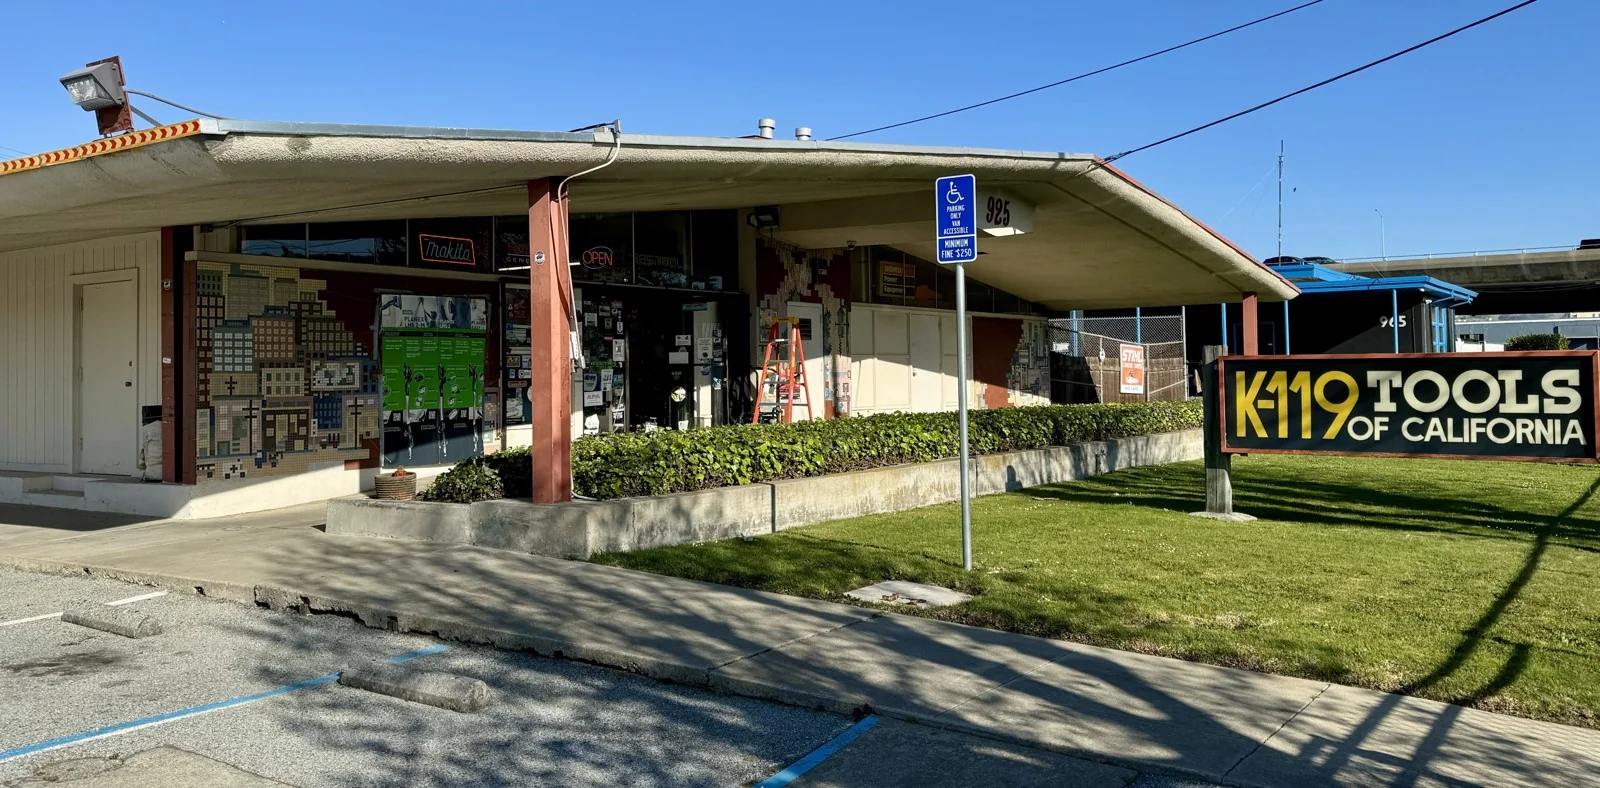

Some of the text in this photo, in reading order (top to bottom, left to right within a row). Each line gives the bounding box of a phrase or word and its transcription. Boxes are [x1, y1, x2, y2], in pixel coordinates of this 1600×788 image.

[950, 212, 961, 220] ONLY
[986, 196, 1010, 227] 925
[943, 227, 969, 235] ACCESSIBLE
[944, 239, 969, 248] MINIMUM
[583, 250, 613, 266] OPEN
[941, 248, 972, 258] FINE $250
[1236, 369, 1583, 440] K-119 TOOLS
[1347, 416, 1588, 446] OF CALIFORNIA
